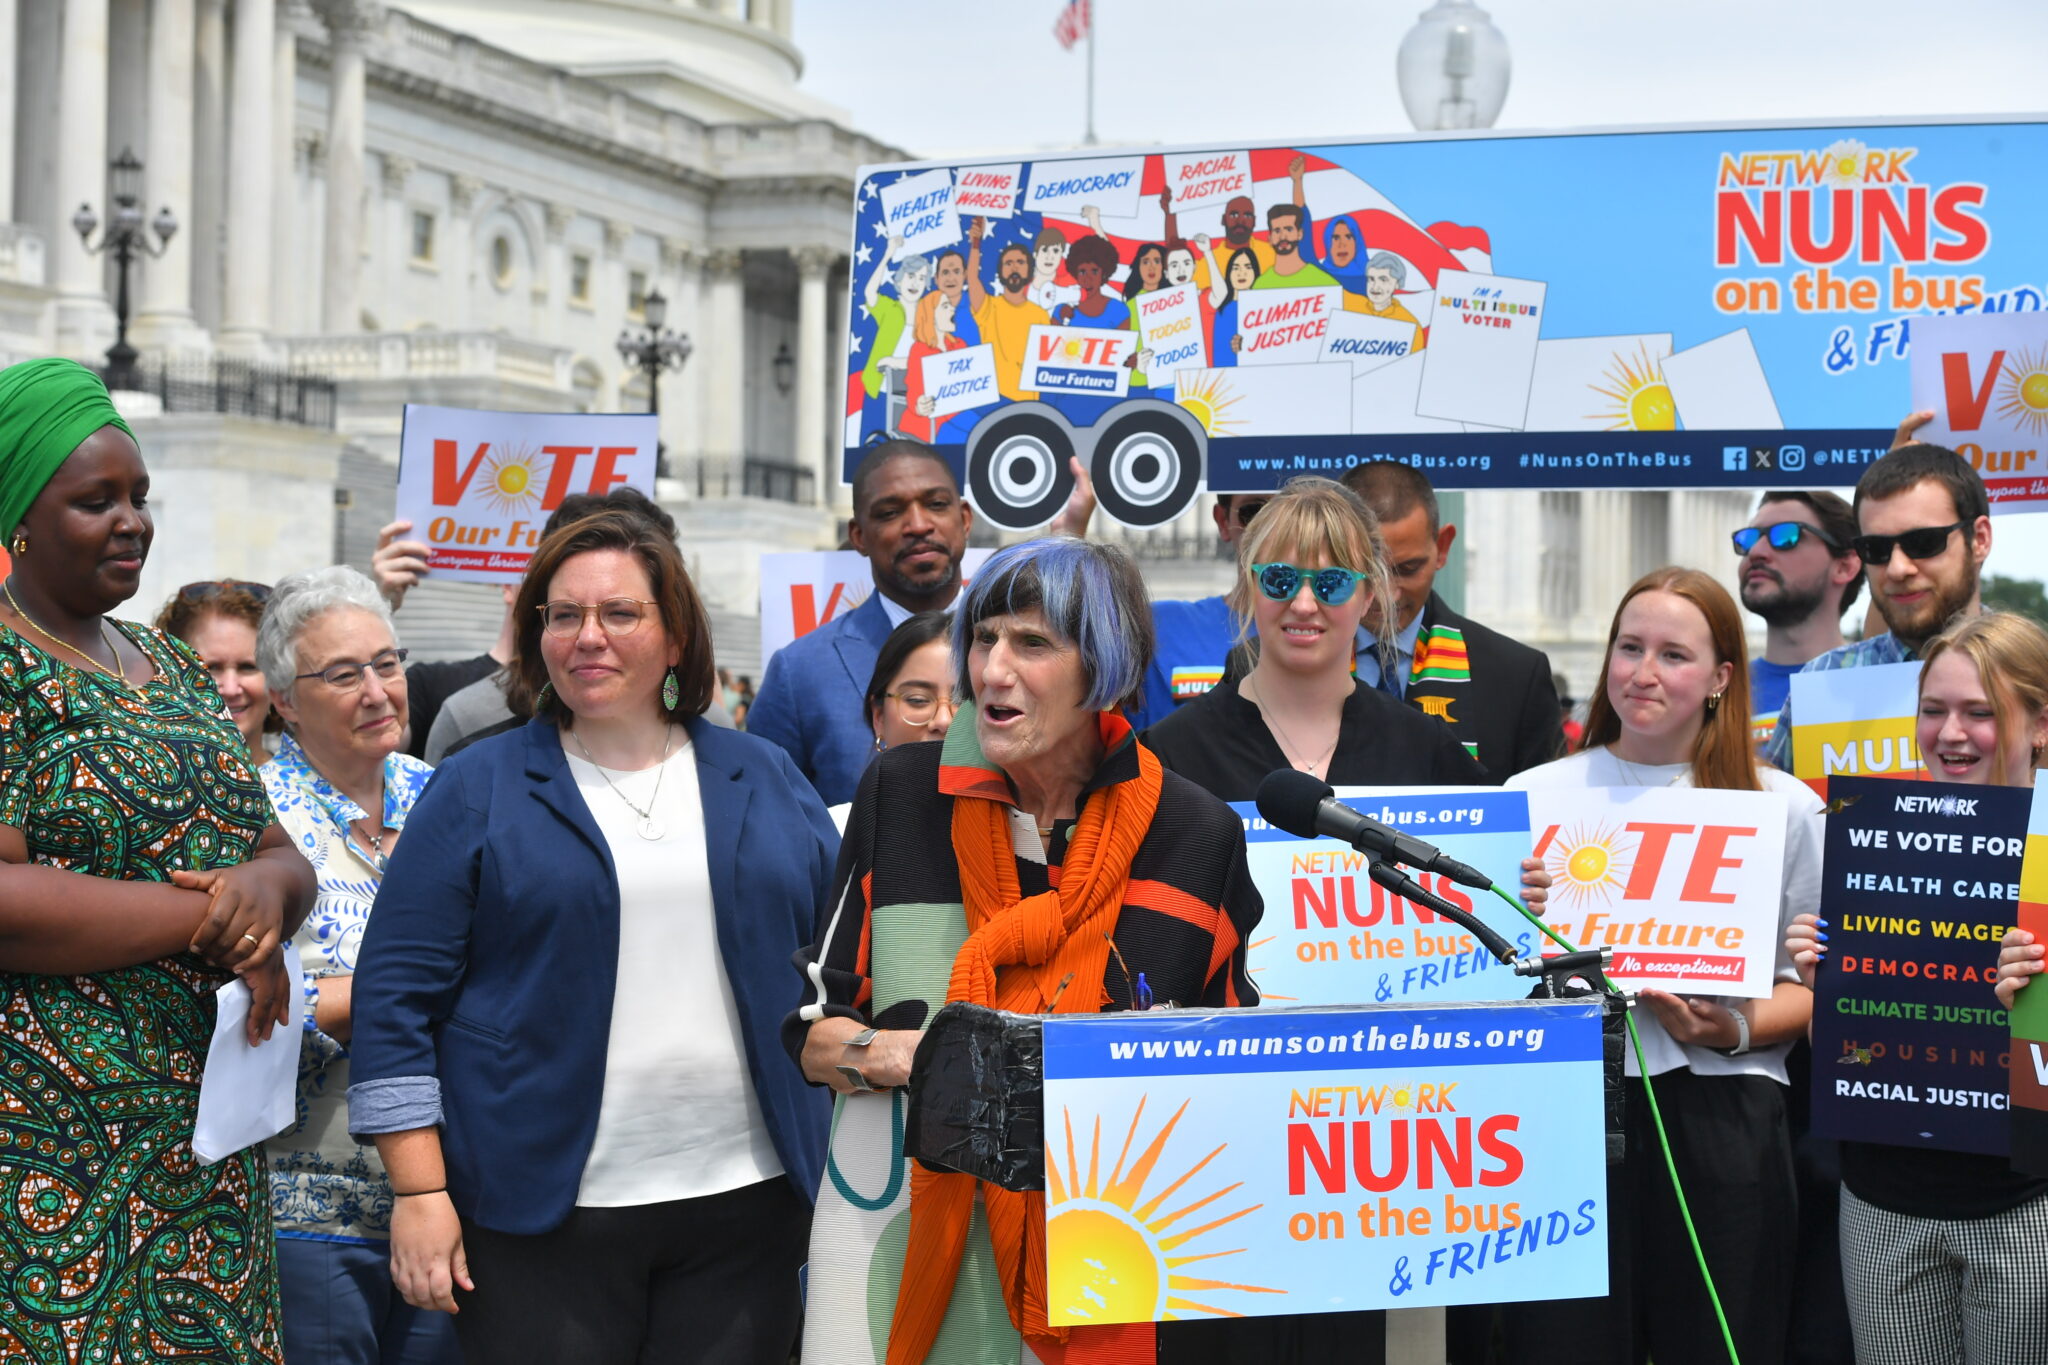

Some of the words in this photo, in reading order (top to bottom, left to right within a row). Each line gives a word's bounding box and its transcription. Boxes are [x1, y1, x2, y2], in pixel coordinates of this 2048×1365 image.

[961, 172, 1012, 189] LIVING
[1179, 155, 1236, 181] RACIAL
[1034, 170, 1135, 200] DEMOCRACY
[1175, 173, 1246, 202] JUSTICE
[890, 187, 951, 223] HEALTH
[955, 191, 1012, 209] WAGES
[903, 210, 945, 239] CARE
[1716, 185, 1988, 265] NUNS
[1141, 290, 1185, 316] TODOS
[1716, 281, 1777, 310] on
[1793, 268, 1878, 310] the
[1892, 267, 1983, 309] bus
[1243, 294, 1325, 329] CLIMATE
[1440, 296, 1486, 311] MULTI
[1493, 301, 1537, 316] ISSUE
[1462, 313, 1512, 328] VOTER
[1148, 317, 1192, 341] TODOS
[1247, 318, 1328, 352] JUSTICE
[1155, 343, 1198, 368] TODOS
[1329, 338, 1408, 356] HOUSING
[1827, 329, 1853, 371] &
[947, 357, 973, 374] TAX
[1037, 371, 1064, 385] Our
[1066, 373, 1115, 389] Future
[933, 375, 992, 400] JUSTICE
[1520, 452, 1692, 467] #NunsOnTheBus
[428, 517, 500, 544] Our
[1849, 828, 1888, 849] WE
[1897, 831, 1962, 853] VOTE
[1972, 836, 2023, 857] FOR
[1291, 871, 1474, 930] NUNS
[1846, 873, 1942, 895] HEALTH
[1953, 880, 2020, 901] CARE
[1579, 913, 1744, 950] Future
[1843, 914, 1921, 936] LIVING
[1296, 940, 1339, 963] on
[1349, 931, 1404, 961] the
[1414, 929, 1474, 957] bus
[1619, 956, 1642, 972] No
[1645, 957, 1742, 979] exceptions!
[1842, 956, 1998, 983] DEMOCRAC
[1375, 973, 1392, 1002] &
[1836, 997, 1928, 1021] CLIMATE
[1932, 1005, 2011, 1027] JUSTIC
[1110, 1025, 1545, 1061] www.nunsonthebus.org
[1836, 1079, 1919, 1103] RACIAL
[1926, 1087, 2010, 1111] JUSTIC
[1288, 1114, 1525, 1196] NUNS
[1289, 1209, 1344, 1241] on
[1358, 1197, 1431, 1237] the
[1446, 1194, 1521, 1234] bus
[1389, 1256, 1412, 1296] &
[1425, 1199, 1597, 1286] FRIENDS
